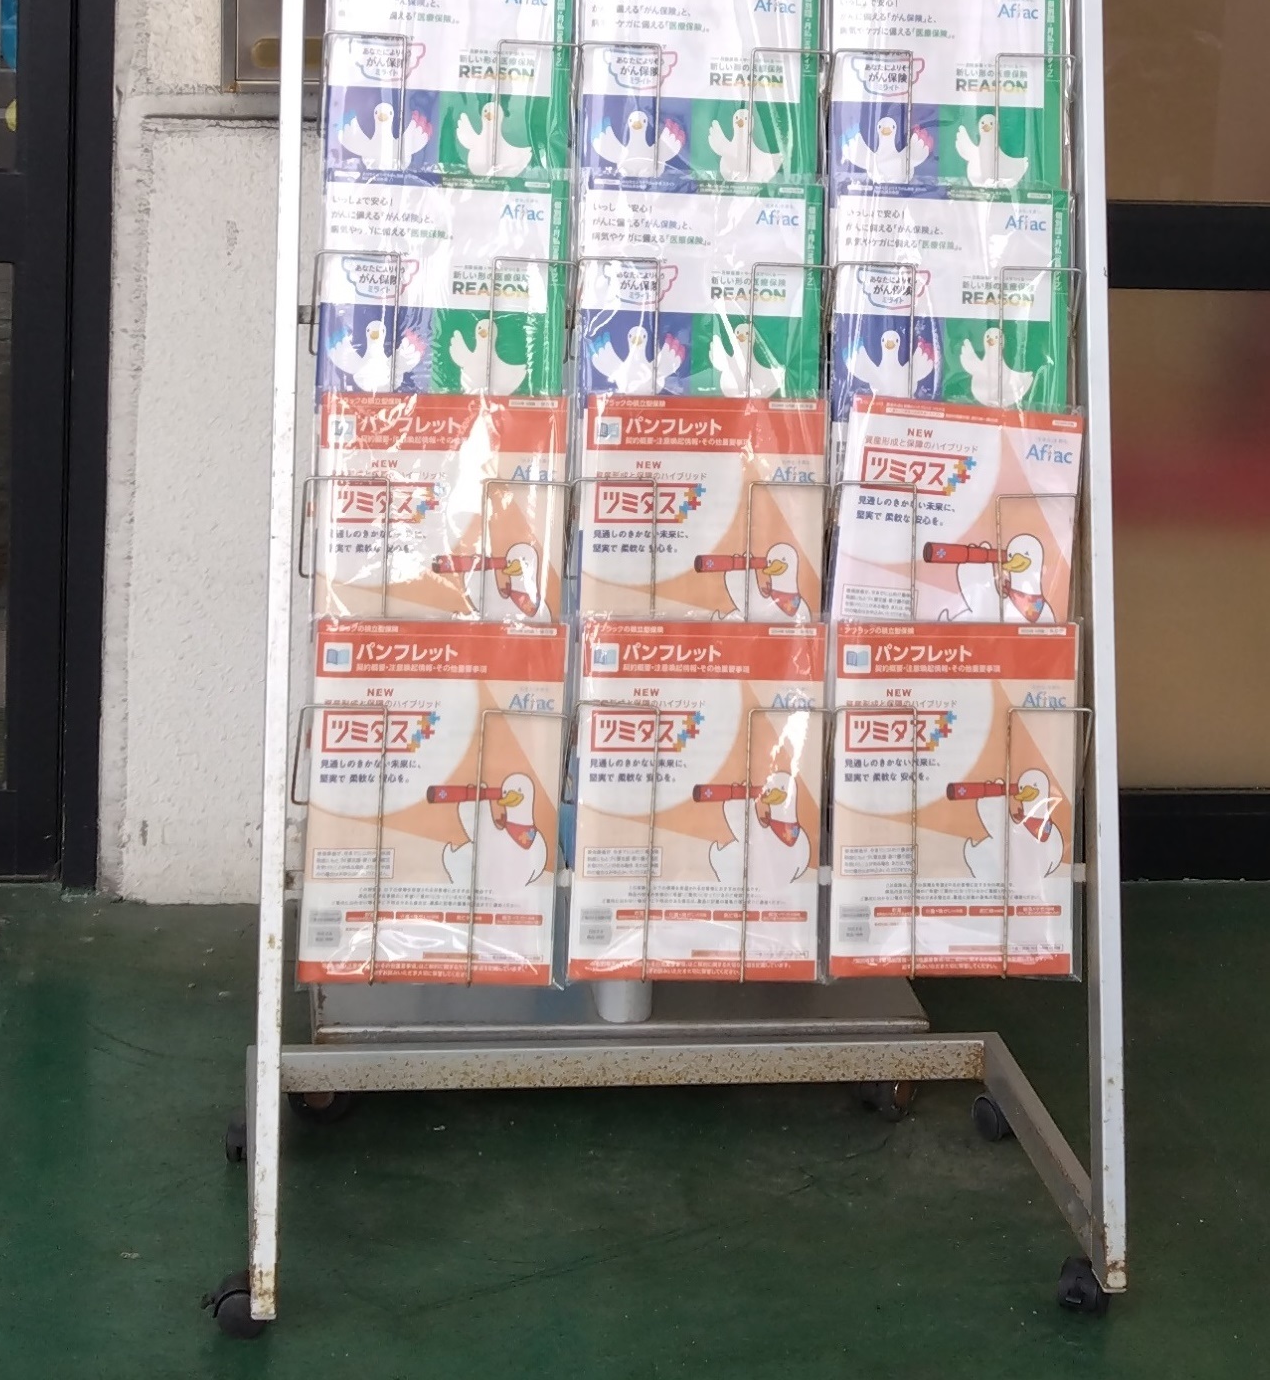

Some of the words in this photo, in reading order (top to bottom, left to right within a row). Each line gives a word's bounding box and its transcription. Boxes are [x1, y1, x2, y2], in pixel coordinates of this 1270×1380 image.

[458, 65, 534, 81] REASON
[620, 65, 659, 77] がん保険
[865, 63, 910, 72] あなたによりそ
[709, 72, 784, 88] REASON
[868, 72, 908, 84] がん保険
[956, 78, 1028, 93] REASON
[452, 281, 529, 299] REASON
[710, 286, 787, 303] REASON
[961, 291, 1035, 307] REASON
[625, 416, 722, 436] パンフレット
[907, 428, 934, 438] NEW
[865, 435, 978, 453] 資産形成と保障のハイブリッド
[372, 460, 398, 468] NEW
[636, 461, 662, 469] NEW
[871, 457, 946, 486] ツミタス
[337, 490, 413, 513] ツミタス
[603, 492, 676, 514] ツミタス
[356, 643, 458, 662] パンフレット
[623, 644, 721, 662] パンフレット
[875, 645, 972, 662] パンフレット
[367, 688, 394, 697] NEW
[634, 688, 660, 697] NEW
[886, 688, 913, 697] NEW
[331, 721, 409, 743] ツミタス
[600, 720, 674, 743] ツミタス
[854, 720, 926, 743] ツミタス
